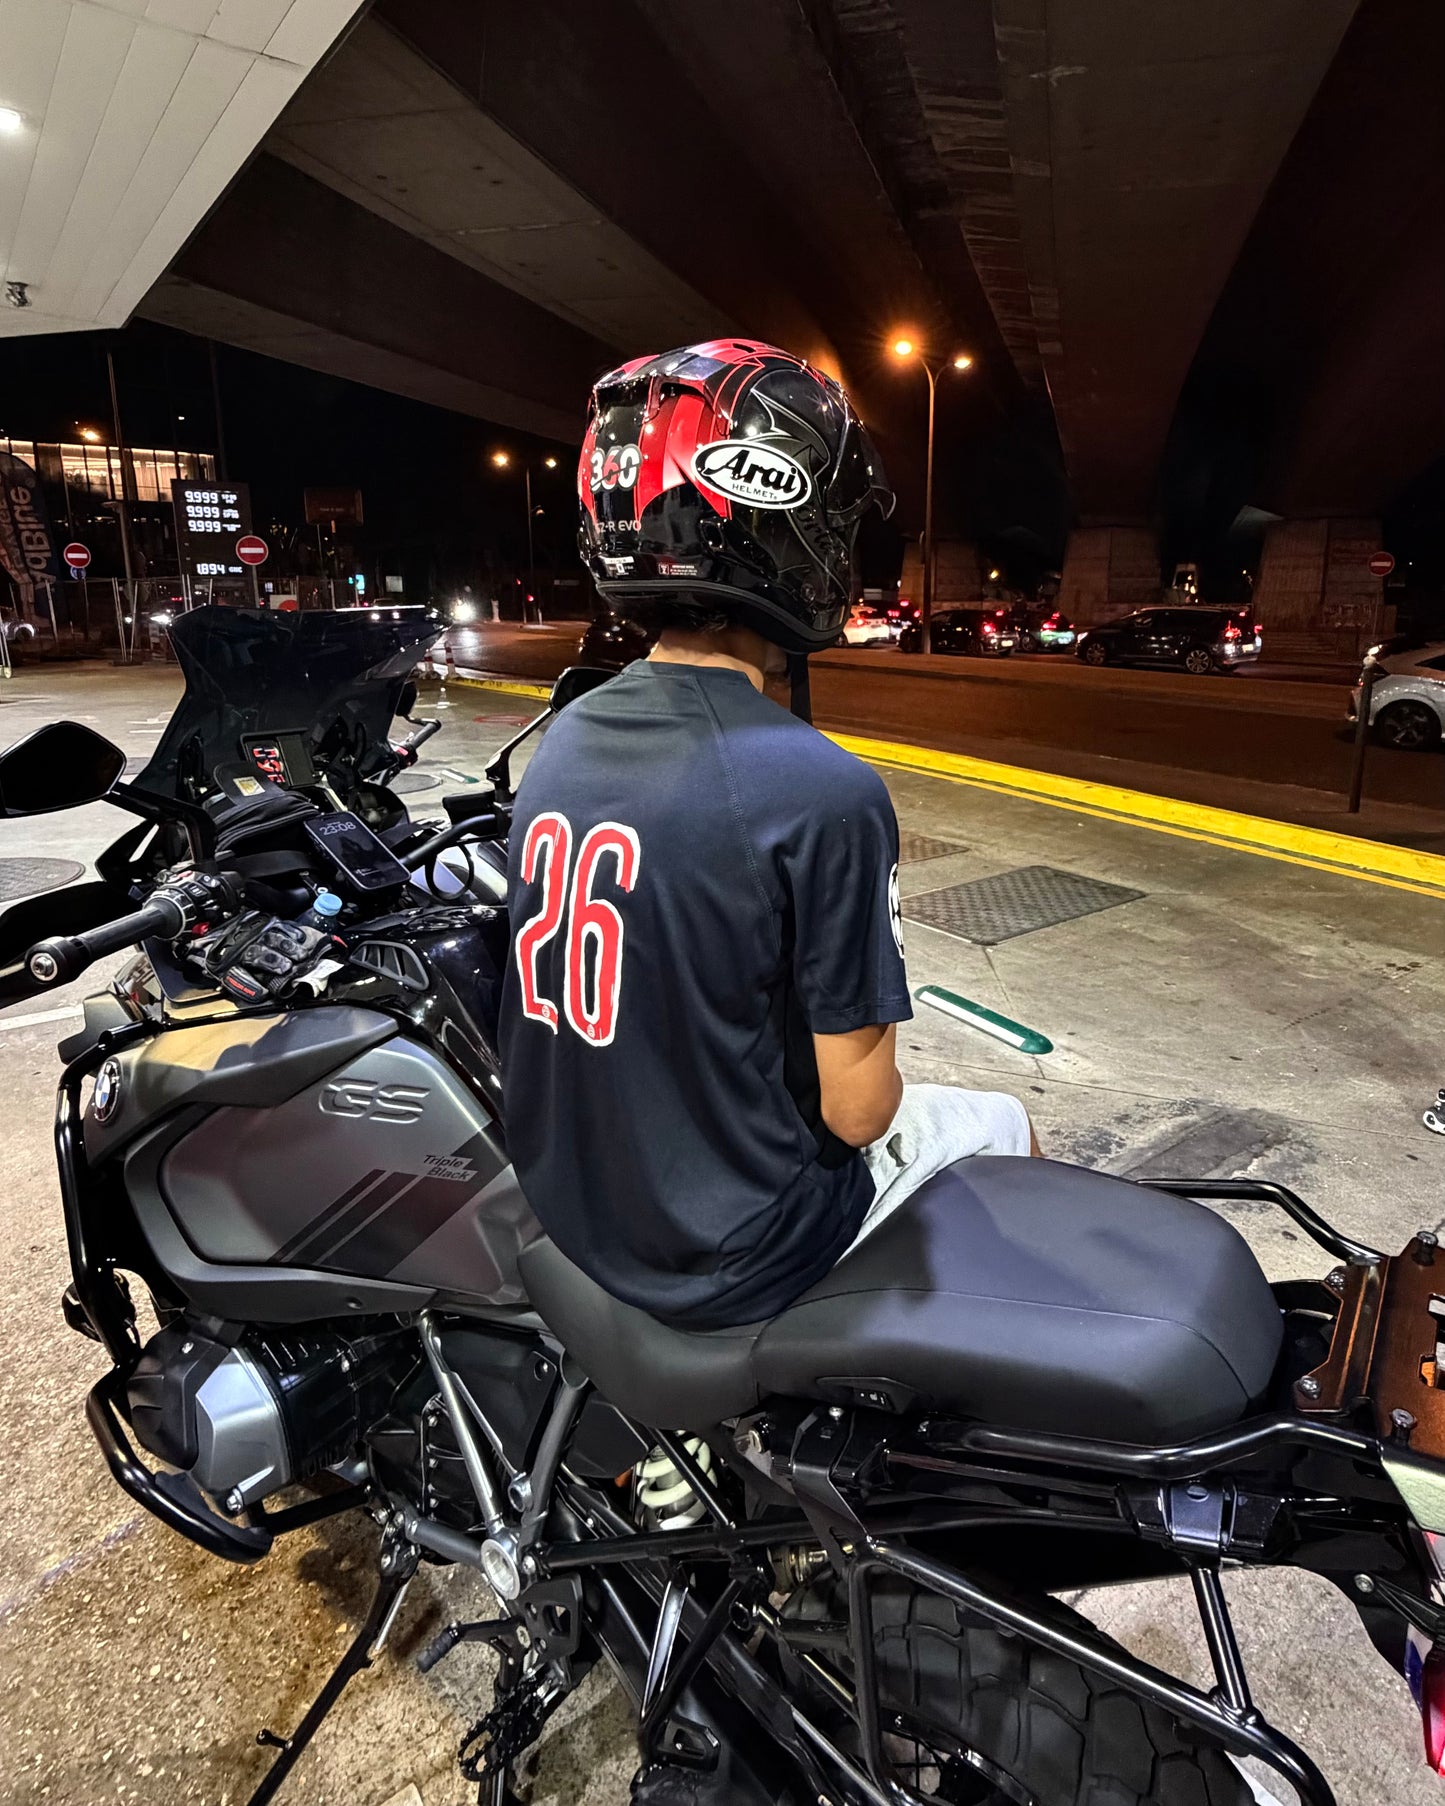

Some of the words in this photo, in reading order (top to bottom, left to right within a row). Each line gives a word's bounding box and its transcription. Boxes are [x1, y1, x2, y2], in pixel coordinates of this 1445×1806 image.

[590, 445, 641, 492] 360
[702, 449, 797, 494] Arai
[732, 483, 774, 499] HELMET
[618, 519, 642, 532] EVO
[319, 821, 357, 836] 23:08
[515, 811, 642, 1047] 26
[318, 1077, 431, 1125] GS
[423, 1154, 465, 1169] Triple
[427, 1166, 471, 1182] Black
